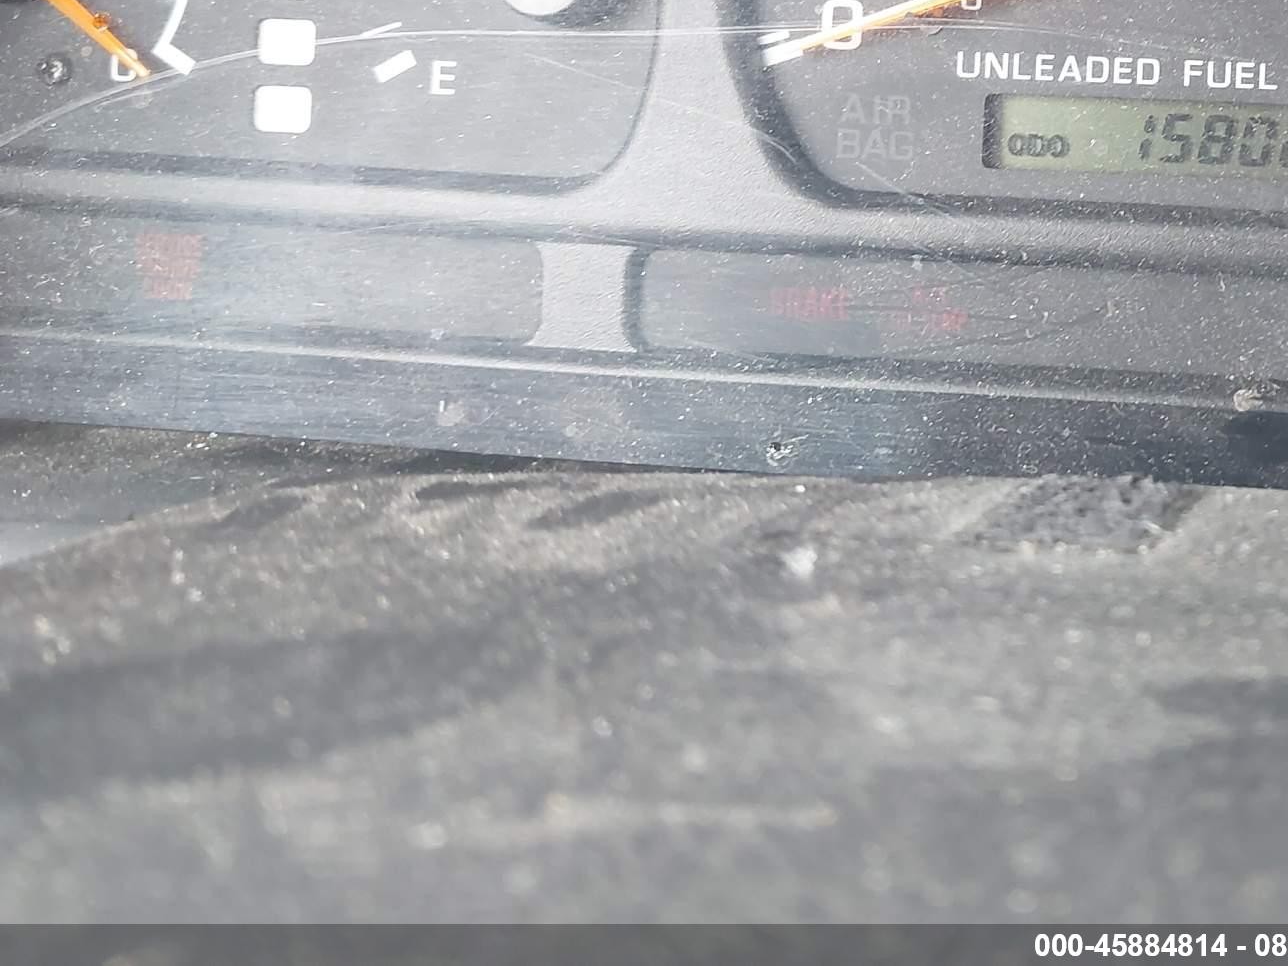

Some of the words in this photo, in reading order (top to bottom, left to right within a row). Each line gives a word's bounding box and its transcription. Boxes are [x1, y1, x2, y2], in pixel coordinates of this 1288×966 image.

[429, 60, 457, 95] E
[956, 50, 1160, 85] UNLEADED
[1183, 59, 1278, 90] FUEL
[836, 128, 914, 160] BAG
